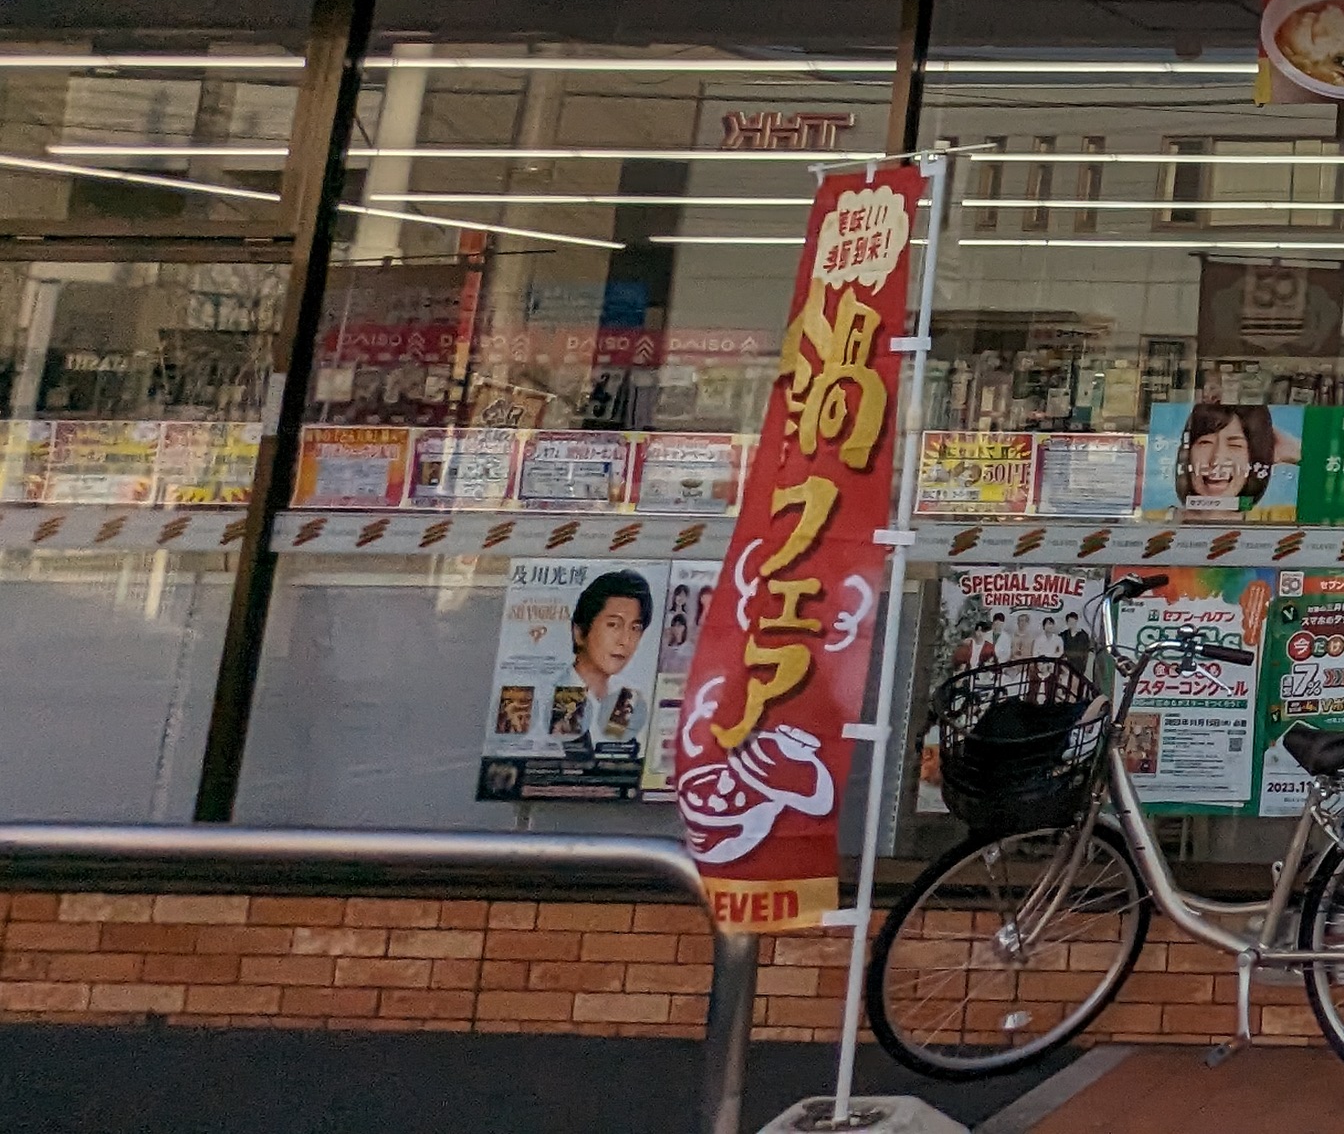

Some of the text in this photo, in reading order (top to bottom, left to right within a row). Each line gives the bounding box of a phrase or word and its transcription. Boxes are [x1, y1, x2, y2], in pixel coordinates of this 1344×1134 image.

[511, 565, 588, 586] 及川光博
[961, 574, 1085, 596] SPECIAL SMILE
[985, 593, 1059, 607] CHRISTMAS
[1124, 680, 1248, 696] スターコンクール
